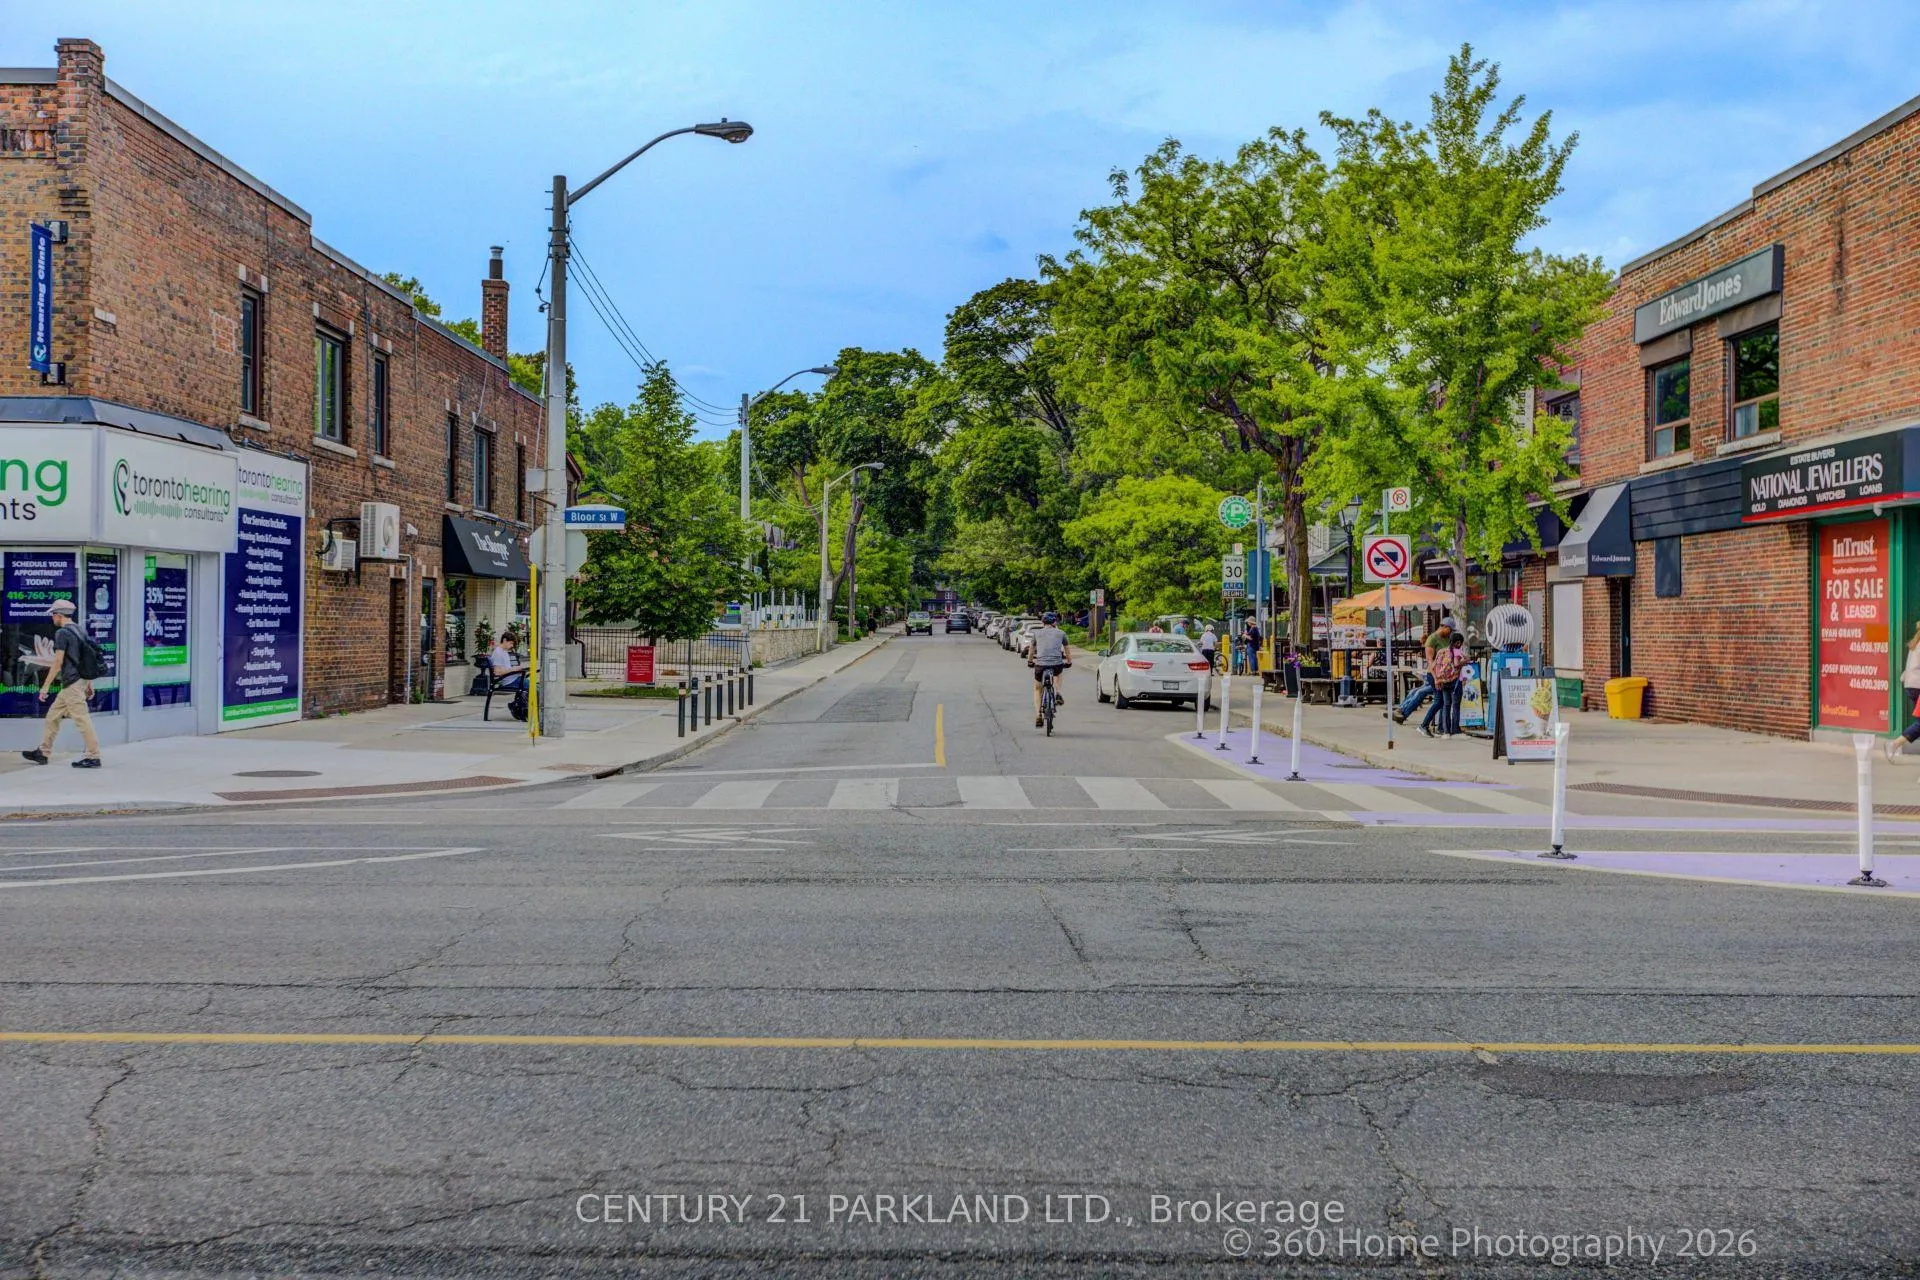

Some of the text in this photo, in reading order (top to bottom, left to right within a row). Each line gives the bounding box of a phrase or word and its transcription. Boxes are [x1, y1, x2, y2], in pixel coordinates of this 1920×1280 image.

[37, 237, 47, 343] Hearing Clinic
[1790, 447, 1836, 466] ESTATE BUYERS
[238, 466, 303, 500] torontohearing
[1751, 453, 1883, 501] NATIONAL JEWELLERS
[133, 470, 231, 515] torontohearing
[1751, 483, 1883, 513] GOLD DIAMONDS WATCHES LOANS
[184, 506, 224, 523] consultants
[571, 511, 618, 522] Bloor St W
[1833, 535, 1875, 558] InTrust
[11, 560, 68, 568] SCHEDULE YOUR
[1225, 566, 1242, 578] 30
[13, 569, 64, 577] APPOINTMENT
[25, 578, 54, 586] TODAY!
[1826, 577, 1884, 600] FOR SALE
[7, 591, 72, 600] 416-760-7999
[145, 587, 164, 604] 35%
[1830, 601, 1877, 622] & LEASED
[145, 620, 164, 637] 90%
[1838, 627, 1862, 639] GRAVES
